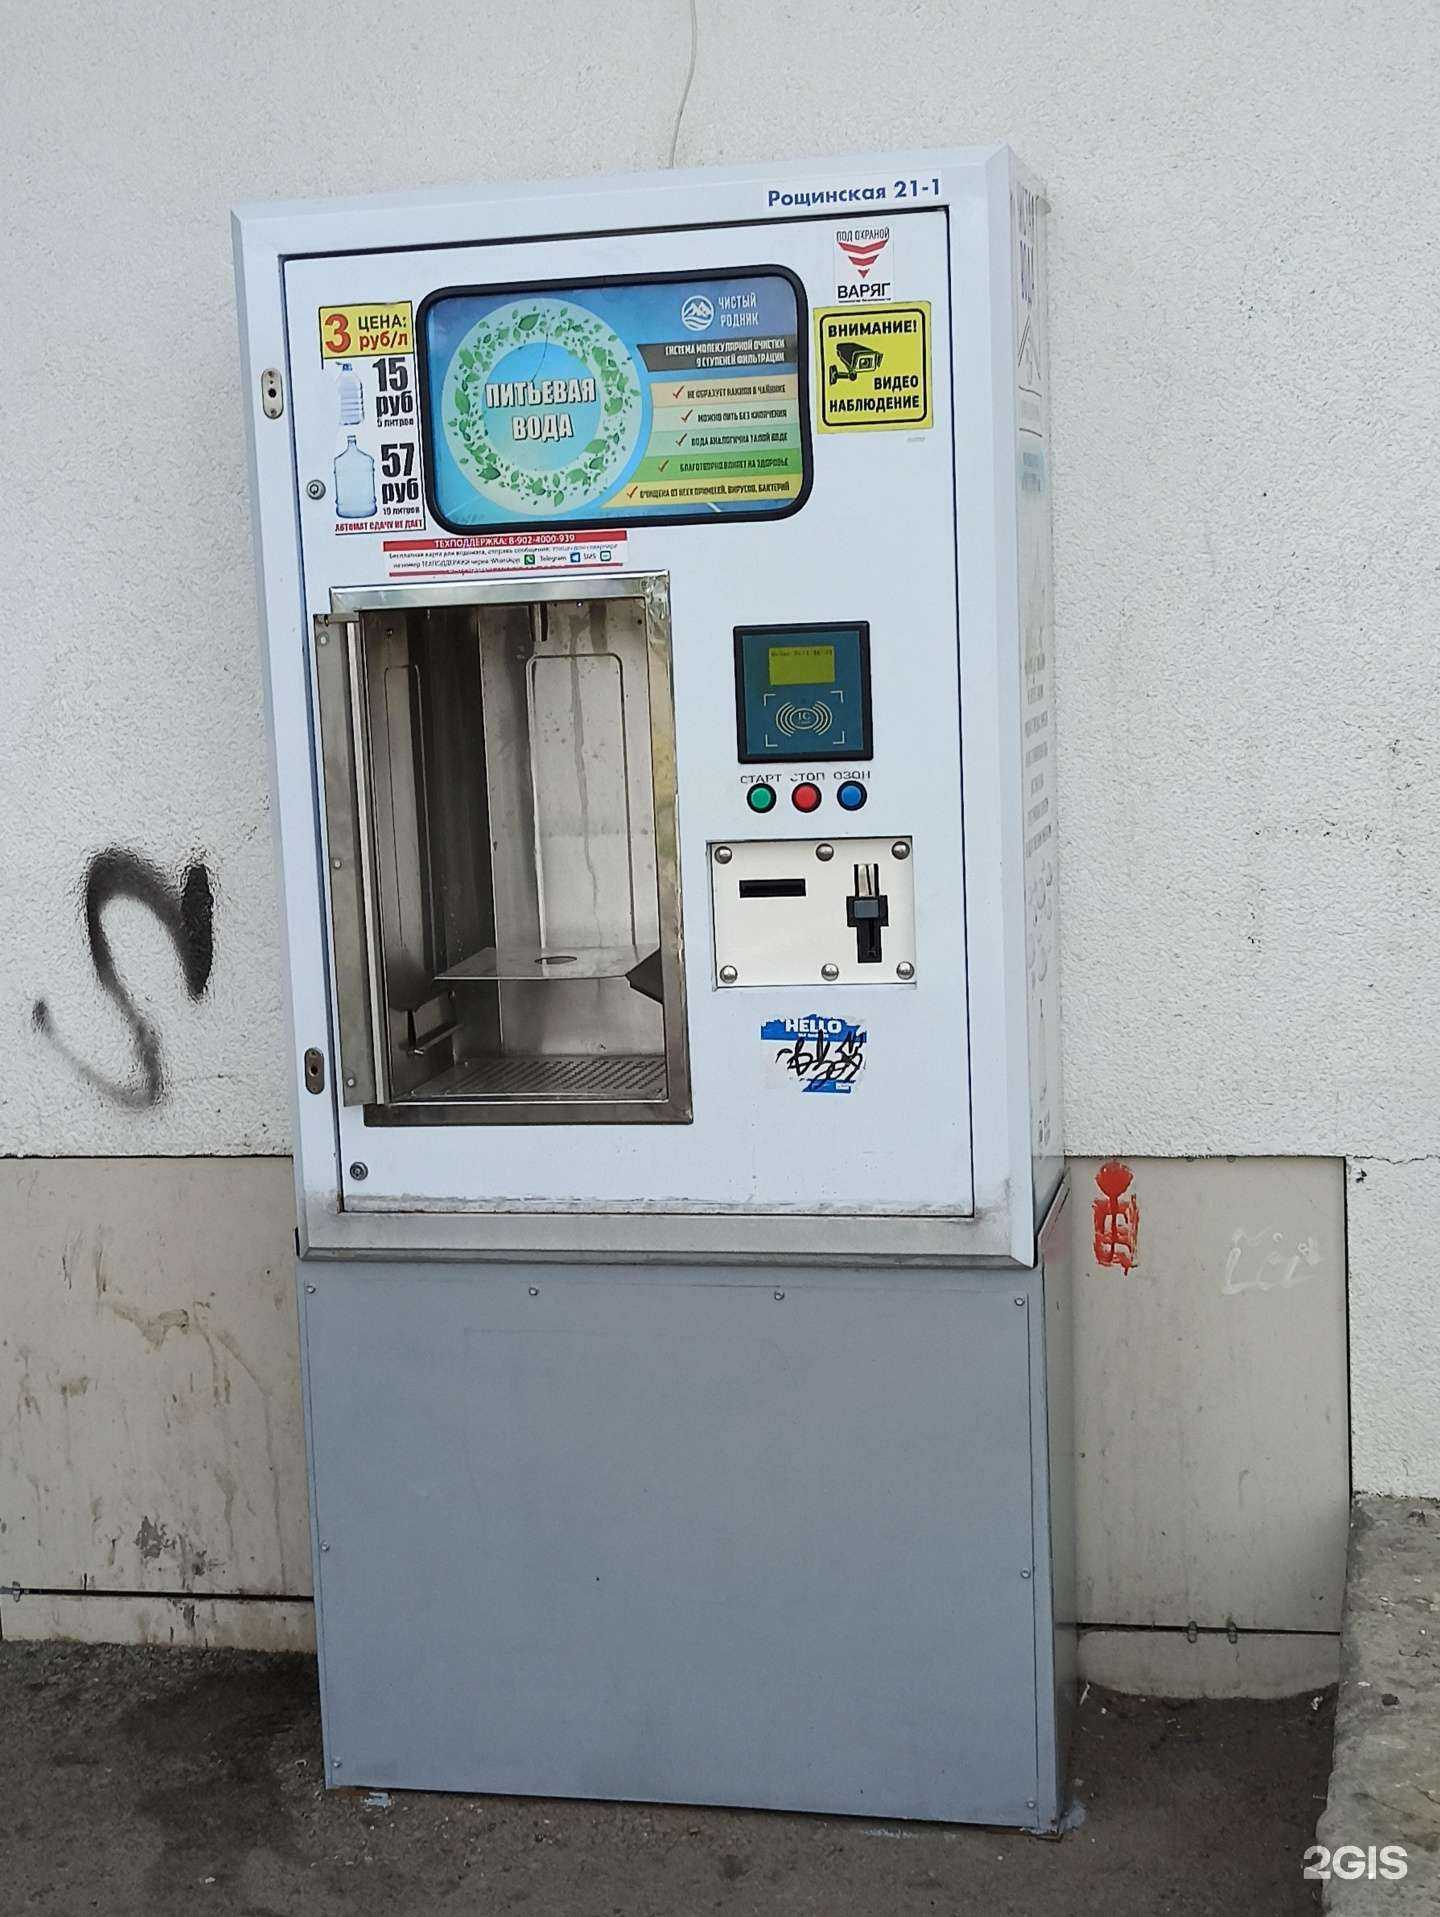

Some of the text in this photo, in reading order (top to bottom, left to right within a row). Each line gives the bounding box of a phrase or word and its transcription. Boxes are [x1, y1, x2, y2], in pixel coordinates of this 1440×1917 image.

[768, 178, 940, 207] Рощинская 21-1
[836, 227, 890, 242] ПОД ОХРАНОЙ
[838, 282, 890, 299] ВАРЯГ
[718, 291, 757, 309] ЧИСТЫЙ
[357, 315, 407, 332] ЦЕНА:
[720, 312, 759, 328] РОДНИК
[828, 320, 917, 337] ВНИМАНИЕ!
[323, 313, 351, 353] 3
[359, 330, 408, 351] руб/л
[665, 338, 785, 355] СИСТЕМА МОЛЕКУЛЯРНОЙ ОЧИСТКИ
[702, 354, 736, 367] СТУПЕНЕЙ
[736, 351, 785, 364] ФИЛЬТРАЦИИ
[372, 357, 409, 392] 15
[485, 377, 596, 408] ПИТЬЕВАЯ
[873, 375, 919, 393] ВИДЕО
[376, 390, 414, 418] руб
[829, 395, 919, 413] НАБЛЮДЕНИЕ
[512, 414, 574, 442] ВОДА
[691, 436, 709, 447] ВОДА
[381, 442, 415, 477] 57
[382, 478, 419, 504] руб
[334, 522, 368, 532] АВТОМАТ
[369, 520, 394, 531] СДАЧУ
[434, 534, 576, 549] ТЕХПОДДЕРЖКА: 8-902-4000-939
[740, 770, 871, 784] СТАРТ СТОП ОЗОН
[785, 1018, 843, 1034] HELLO
